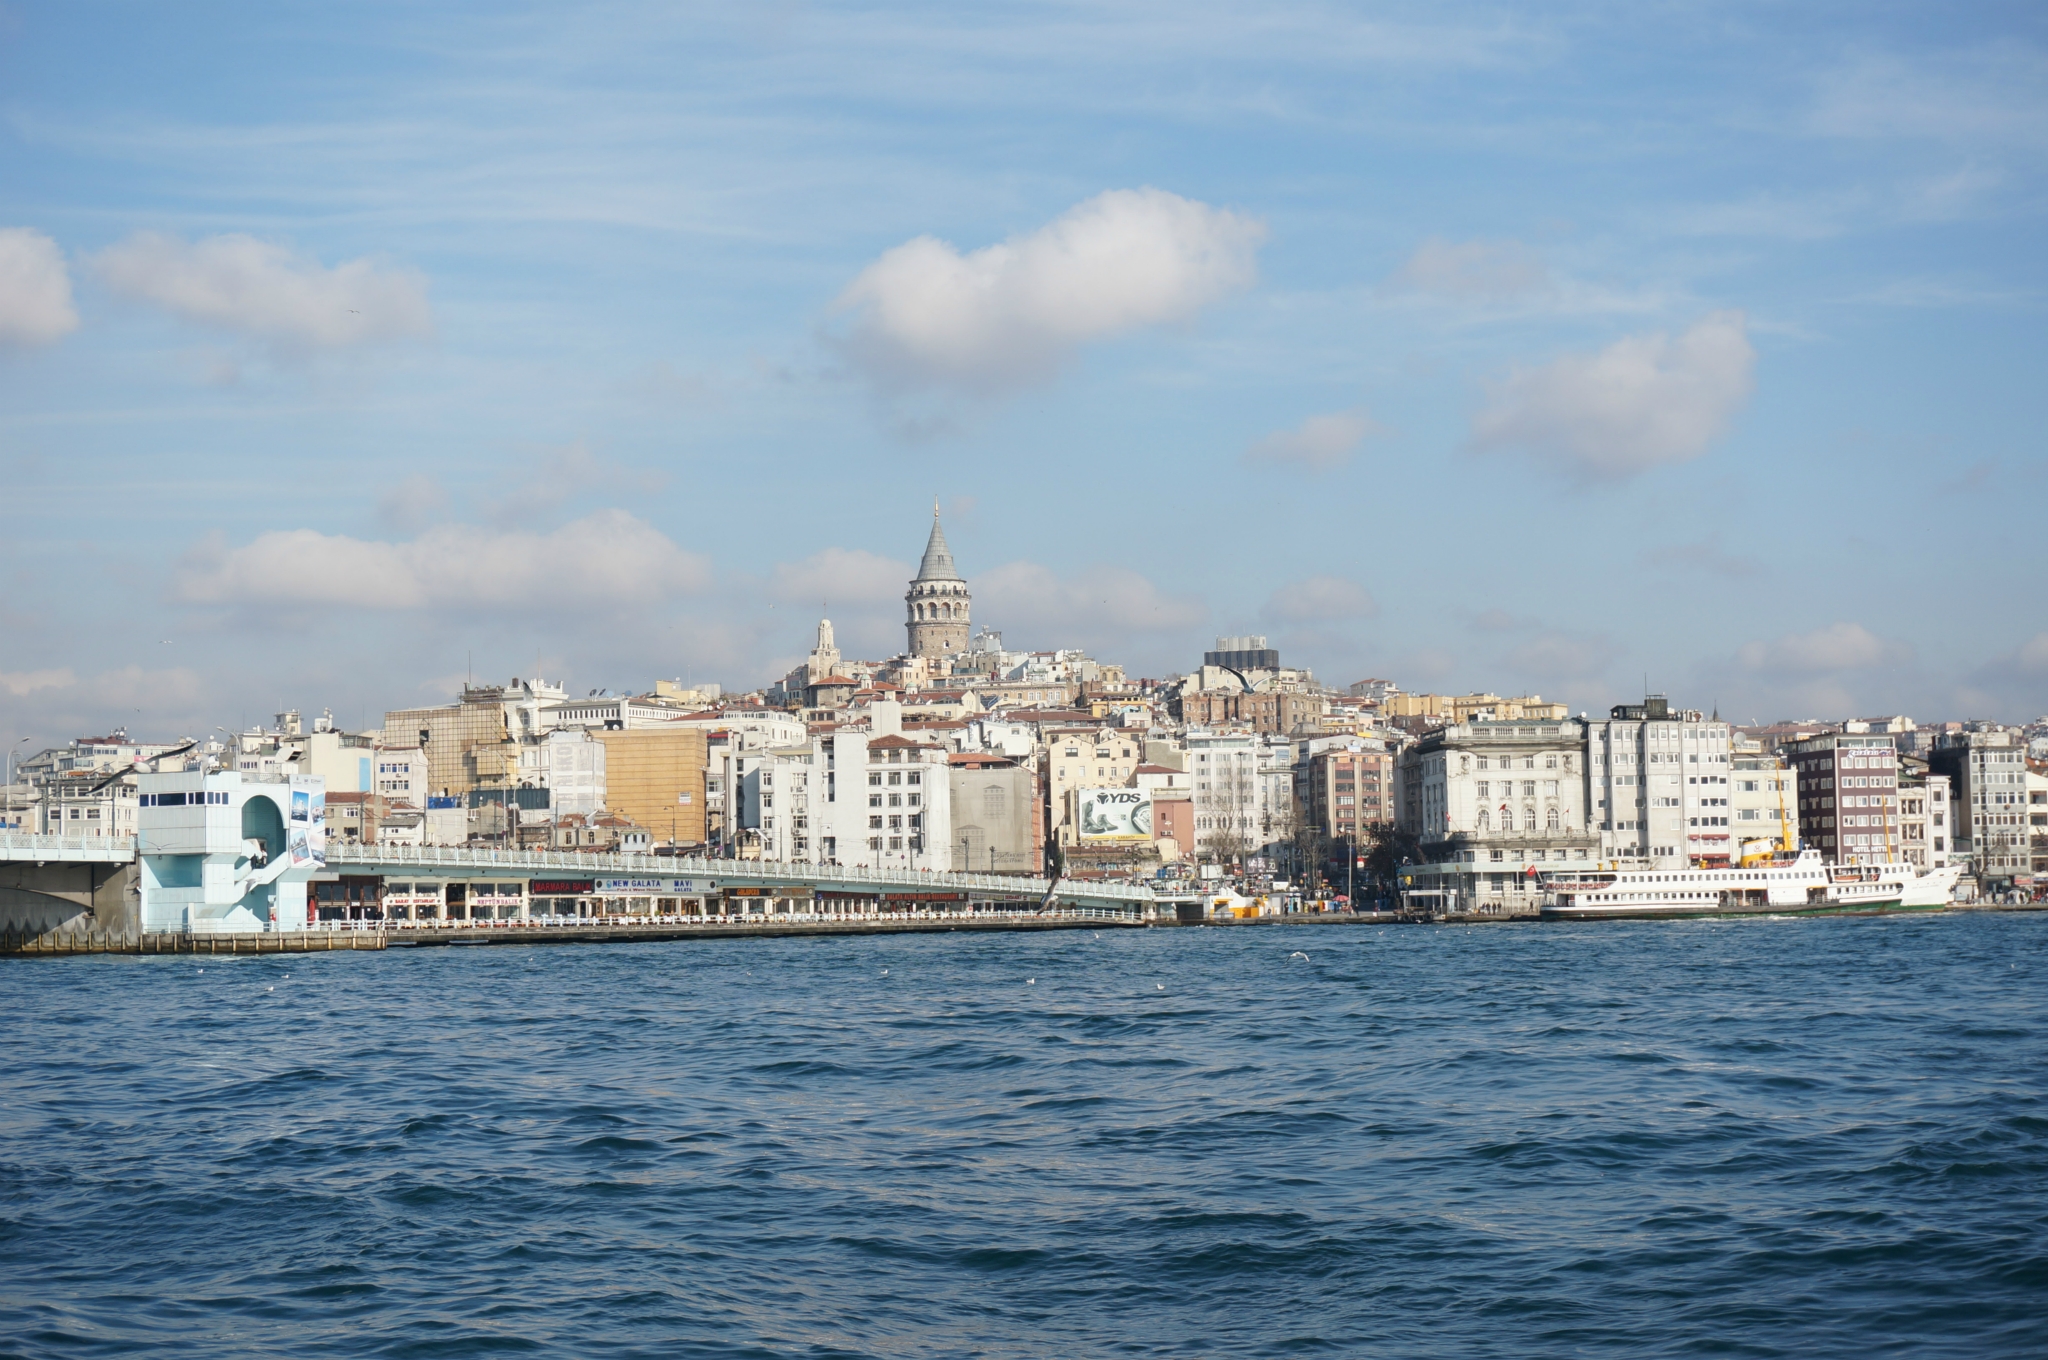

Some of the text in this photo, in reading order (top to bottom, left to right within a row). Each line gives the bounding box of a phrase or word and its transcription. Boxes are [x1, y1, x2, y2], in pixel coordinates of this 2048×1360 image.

[1109, 793, 1141, 803] YDS
[534, 882, 570, 892] MARMARA
[572, 882, 592, 891] BALIK
